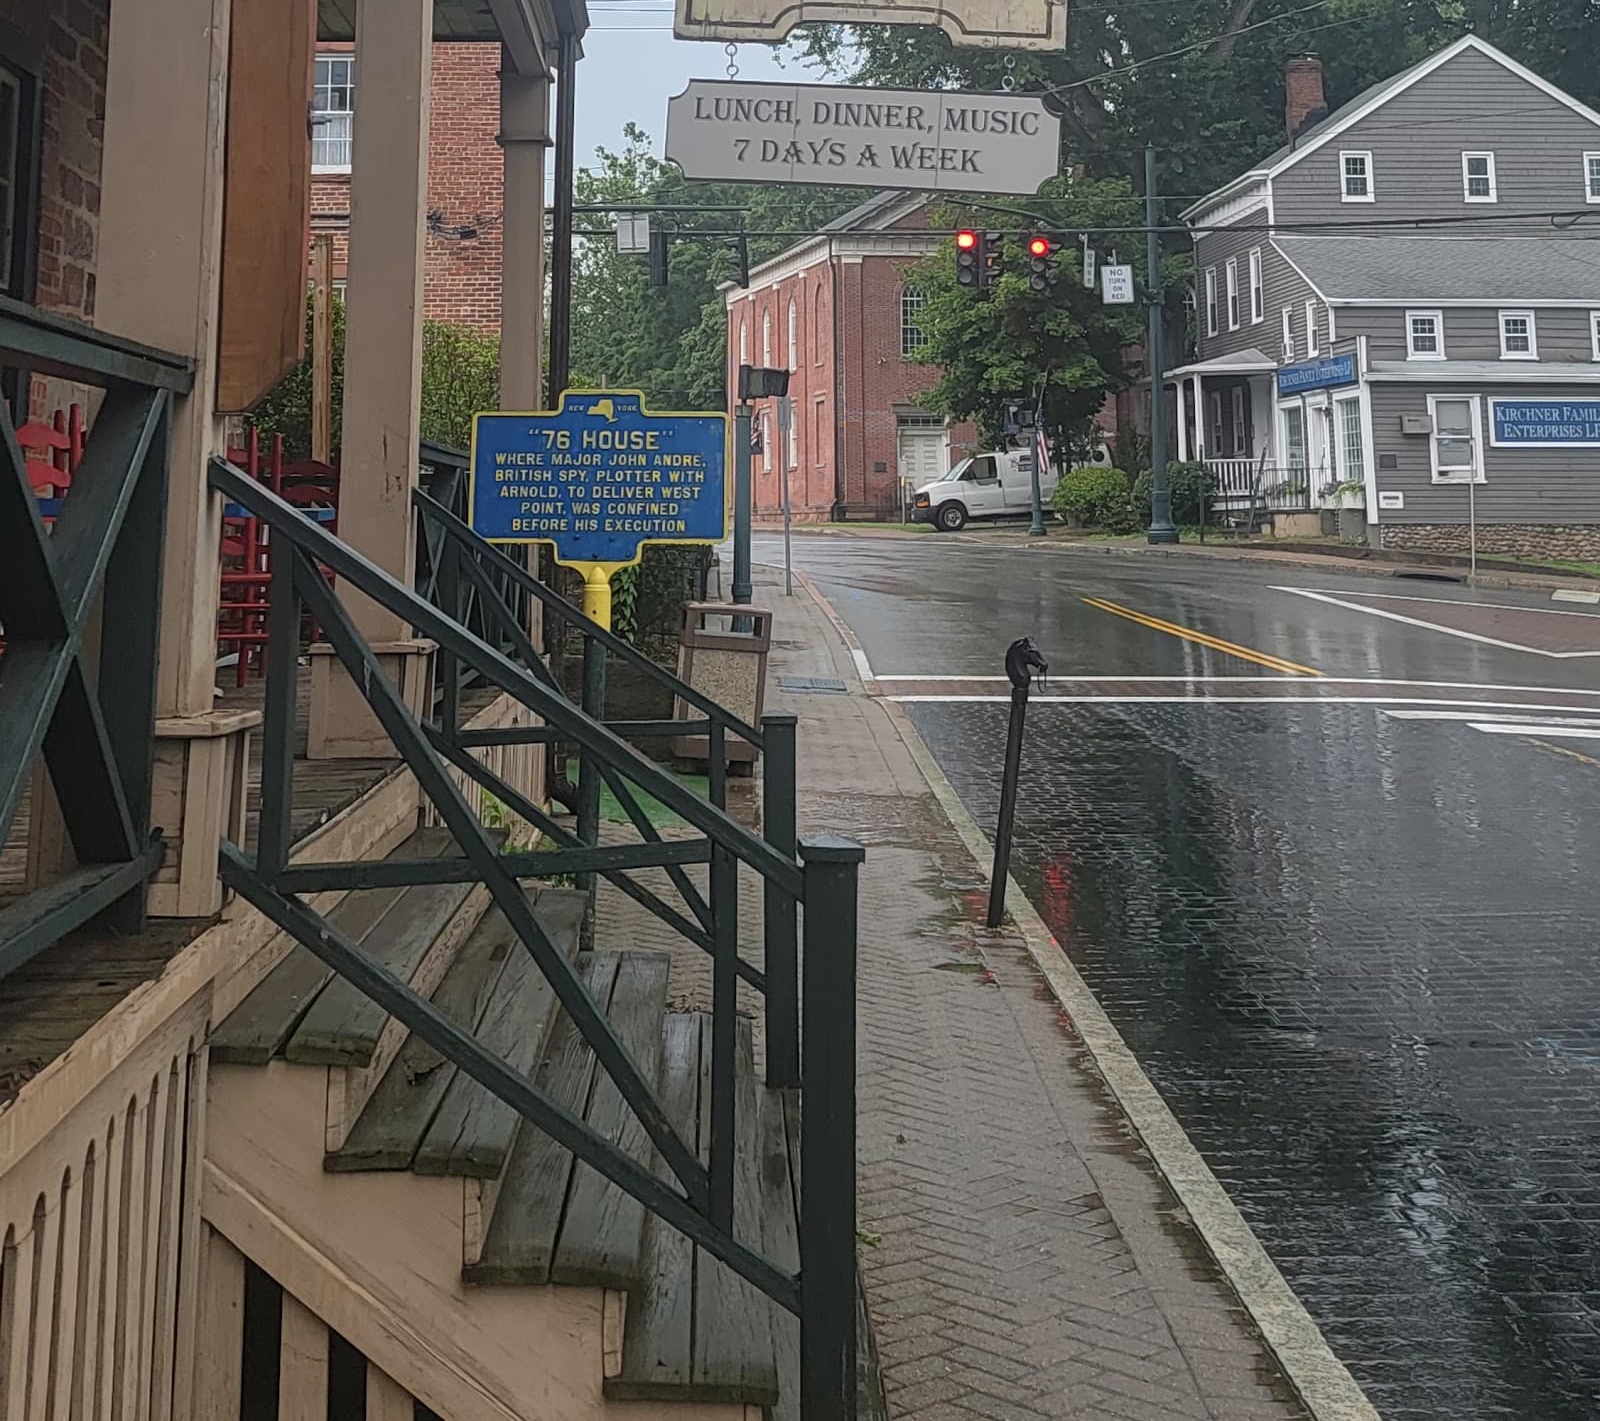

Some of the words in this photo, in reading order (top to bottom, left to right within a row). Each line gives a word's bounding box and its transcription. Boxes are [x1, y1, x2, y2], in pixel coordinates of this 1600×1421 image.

[694, 96, 801, 125] LUNCH,
[812, 101, 934, 134] DINNER,
[943, 107, 1041, 136] MUSIC
[733, 139, 751, 161] 7
[760, 138, 846, 167] DAYS
[857, 143, 880, 168] A
[889, 142, 984, 174] WEEK
[1109, 268, 1123, 277] NO
[1111, 292, 1126, 300] RED
[568, 404, 584, 412] NEW
[617, 404, 638, 412] YORK
[1496, 406, 1560, 421] KIRCHNER
[1563, 406, 1600, 421] FAMIL
[1503, 423, 1583, 438] ENTERPRISES
[529, 429, 570, 450] "76
[582, 430, 674, 451] HOUSE"
[495, 452, 544, 466] WHERE
[551, 453, 601, 466] MAJOR
[608, 453, 647, 467] JOHN
[495, 469, 551, 482] BRITISH
[596, 470, 661, 483] PLOTTER
[669, 470, 704, 484] WITH
[568, 486, 585, 498] TO
[592, 486, 654, 499] DELIVER
[661, 487, 701, 499] WEST
[572, 502, 600, 515] WAS
[607, 502, 679, 516] CONFINED
[512, 518, 568, 531] BEFORE
[575, 519, 598, 532] HIS
[605, 519, 686, 532] EXECUTION
